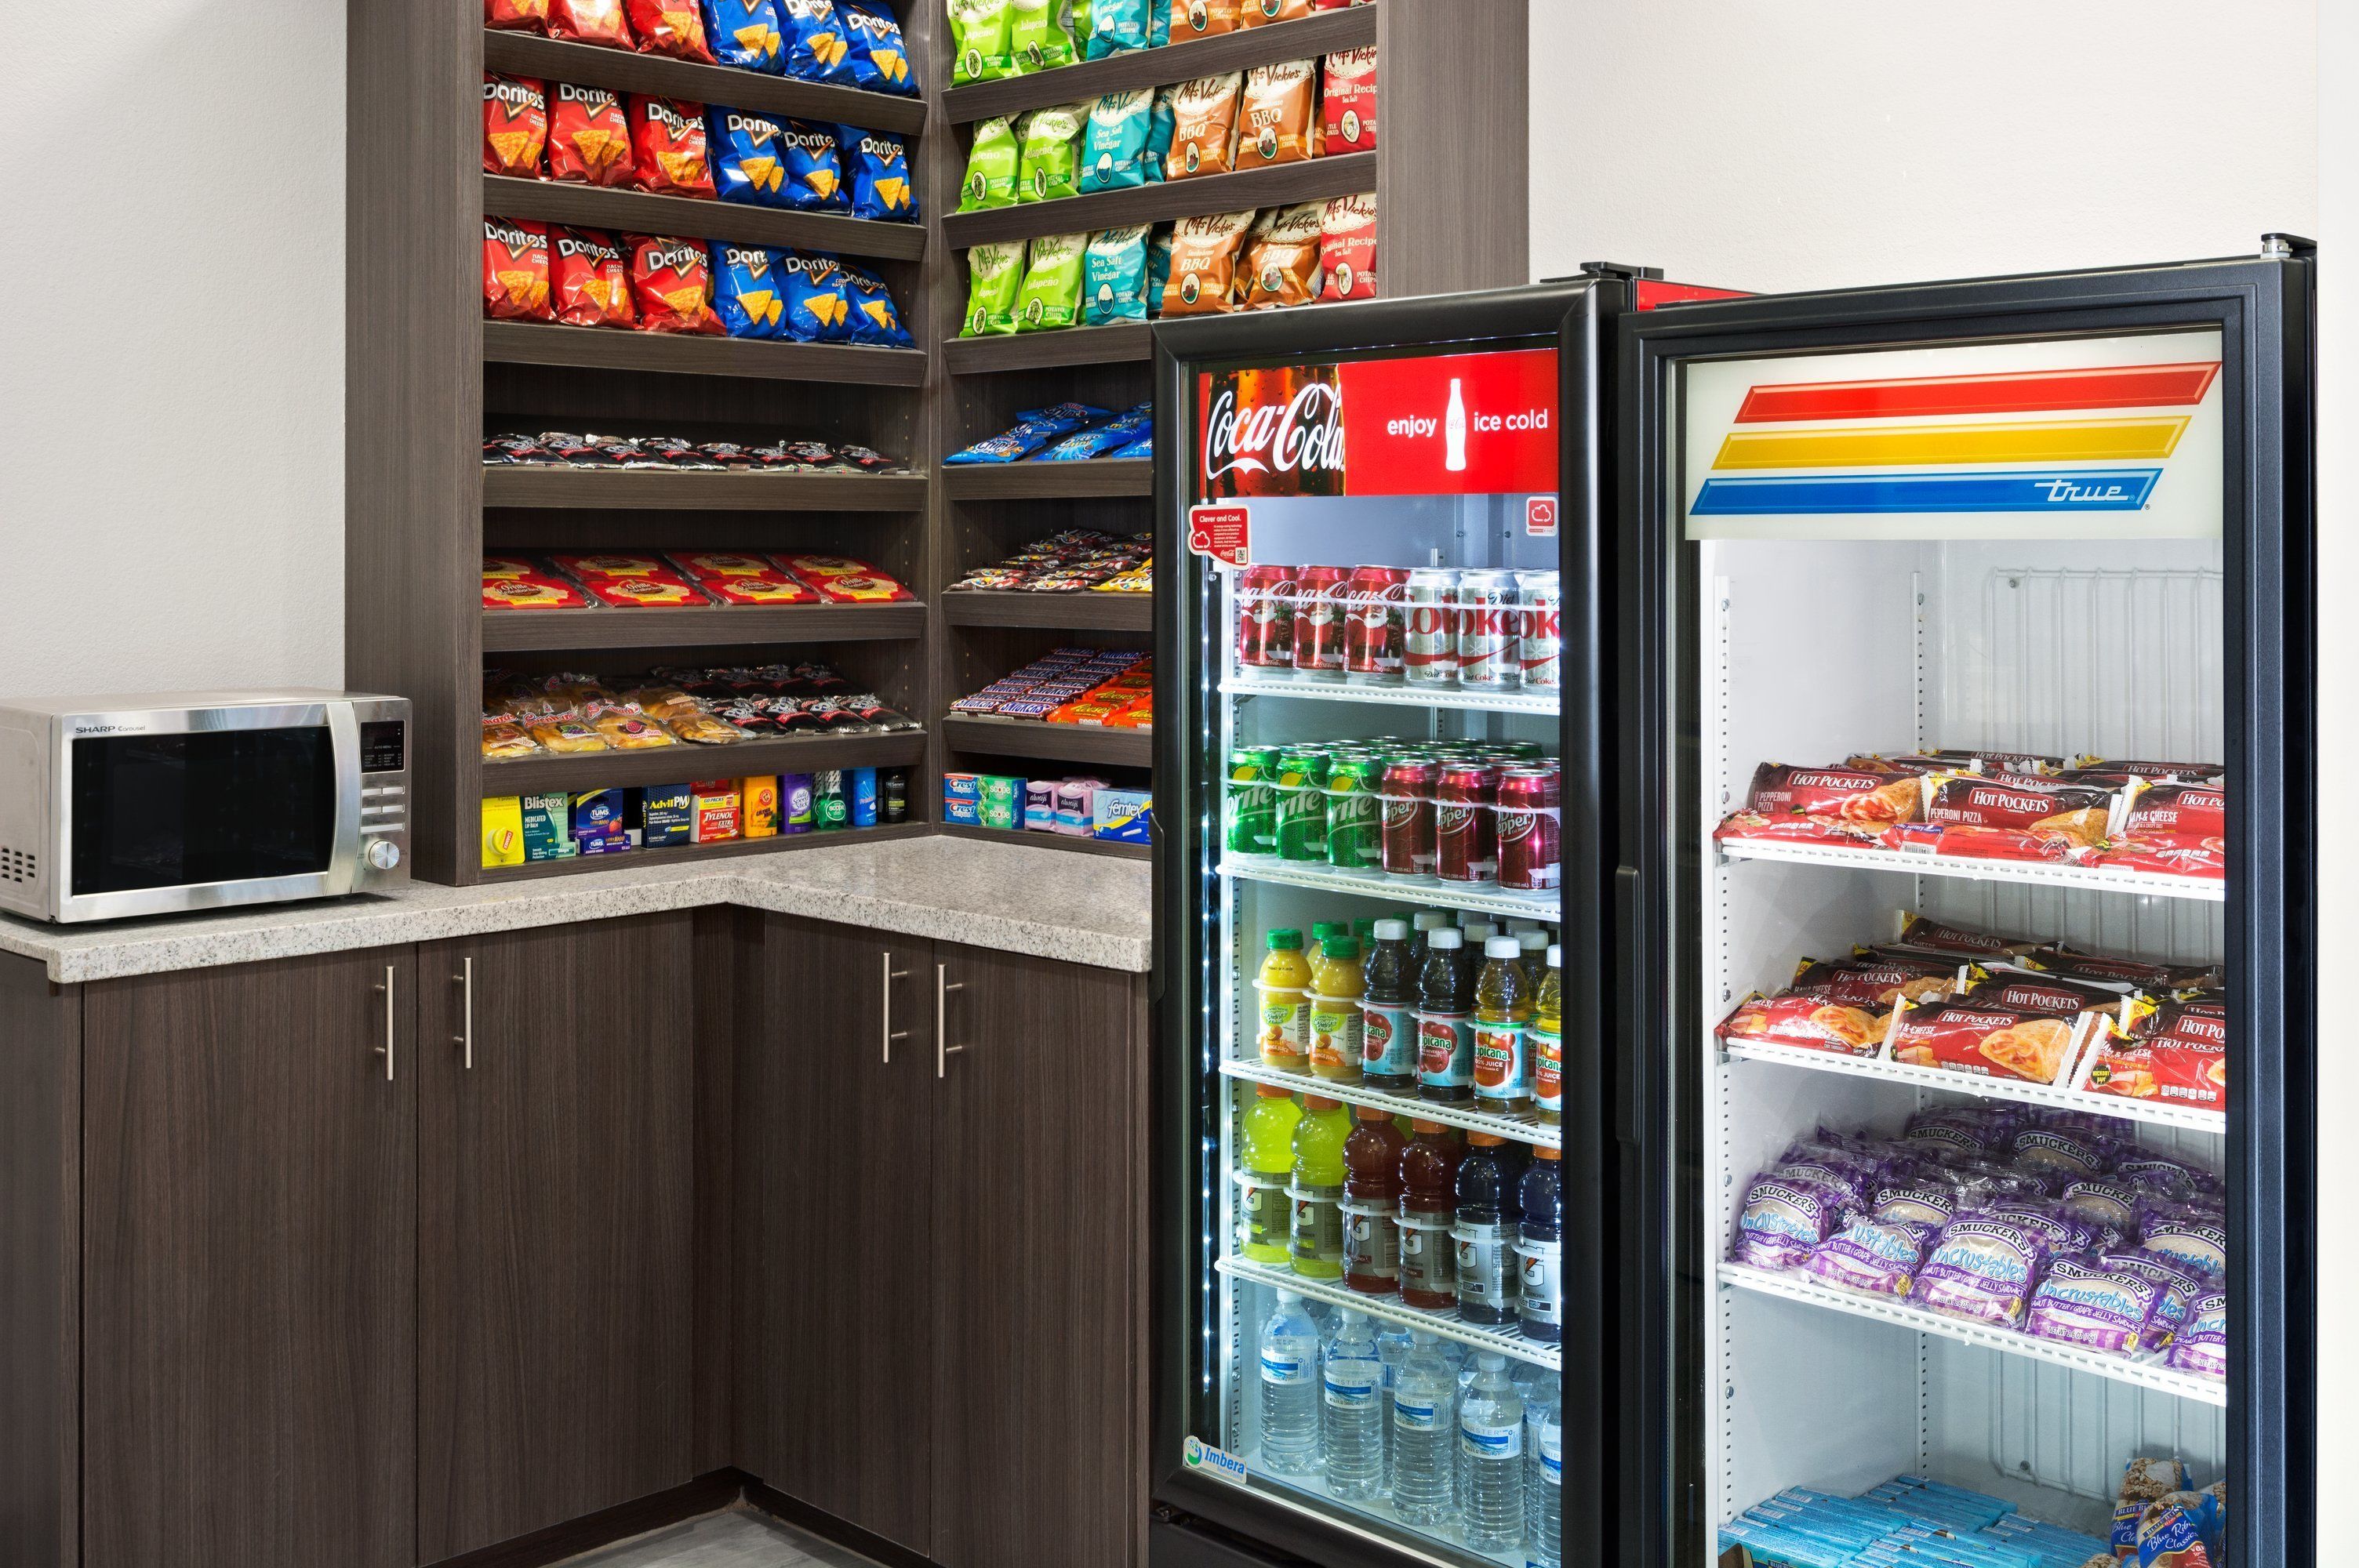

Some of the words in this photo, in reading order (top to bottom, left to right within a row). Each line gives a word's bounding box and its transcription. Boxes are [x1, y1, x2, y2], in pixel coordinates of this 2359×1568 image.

[848, 13, 901, 35] Doritos
[1020, 19, 1048, 31] Jalapeño
[484, 83, 544, 110] Doritos
[560, 83, 617, 107] Dorito
[1324, 85, 1352, 99] Original
[1350, 95, 1358, 103] Salt
[649, 103, 704, 130] Doritos
[1250, 107, 1283, 128] BBQ
[1096, 129, 1109, 139] Sea
[1110, 125, 1122, 137] Salt
[1179, 123, 1205, 142] BBQ
[1094, 140, 1121, 151] Vinegar
[484, 222, 547, 249] Doritos
[558, 239, 619, 260] Doritos
[1260, 248, 1295, 264] BBQ
[1342, 248, 1351, 256] Salt
[649, 245, 707, 270] Doritos
[1092, 258, 1106, 267] Sea
[1107, 256, 1122, 267] Salt
[1180, 257, 1210, 271] BBQ
[1092, 270, 1121, 281] Vinegar
[1027, 277, 1059, 291] Jalapeño
[1387, 414, 1437, 438] enjoy
[1474, 411, 1502, 432] ice
[1505, 408, 1548, 430] cold
[1206, 383, 1345, 480] Coca-Cola
[2034, 479, 2130, 503] true
[1488, 591, 1515, 605] Diet
[75, 725, 115, 734] SHARP
[950, 779, 976, 789] Crest
[990, 786, 1011, 794] scope
[525, 793, 565, 811] Blistex
[649, 800, 673, 810] Advil
[674, 796, 688, 808] PM
[793, 797, 809, 805] Speed
[1029, 793, 1048, 804] always
[1060, 797, 1079, 809] always
[1227, 782, 1274, 819] prite
[1758, 792, 1792, 801] PEPPERONI
[950, 803, 976, 813] Crest
[1107, 800, 1144, 819] femtex
[1757, 801, 1774, 812] PIZZA
[525, 815, 546, 823] MEDICATED
[705, 812, 733, 823] TYLENOL
[989, 810, 1010, 819] scope
[1962, 809, 1983, 824] PIZZA
[2150, 811, 2178, 822] CHEESE
[1812, 984, 1832, 995] CHEESE
[1911, 1025, 1936, 1035] CHEESE
[1543, 1071, 1561, 1080] JUICE
[1909, 1126, 1978, 1151] SMUCKER'S
[2018, 1133, 2096, 1168] SMUCKER'S
[1750, 1185, 1817, 1213] SMUCKER'S
[1950, 1222, 2028, 1253] SMUCKER'S
[1832, 1240, 1851, 1254] BUTTER
[1853, 1247, 1870, 1261] GRAPE
[1870, 1256, 1888, 1271] JELLY
[1887, 1261, 1913, 1276] SANDWICH
[1928, 1244, 2027, 1283] Uncrustables
[1921, 1267, 1940, 1276] PEANUT
[1940, 1269, 1962, 1281] BUTTER
[1980, 1278, 1997, 1293] JELLY
[1997, 1282, 2026, 1298] SANDWICH
[2056, 1263, 2150, 1294] SMUCKER'S
[2036, 1279, 2143, 1322] Uncrustables
[2046, 1299, 2070, 1312] BUTTER
[2073, 1304, 2092, 1317] GRAPE
[2092, 1308, 2111, 1323] JELLY
[2110, 1315, 2143, 1334] SANDWICH
[2066, 1328, 2075, 1338] 2.6
[2076, 1330, 2084, 1340] OZ
[2084, 1332, 2096, 1344] (76g)
[2175, 1335, 2197, 1345] PEANUT
[2197, 1336, 2219, 1345] BUTTER
[2198, 1359, 2208, 1367] NET
[1204, 1446, 1245, 1475] Imbera
[2117, 1504, 2137, 1515] BLUE
[2146, 1533, 2170, 1552] Blue
[2165, 1531, 2199, 1550] Classics
